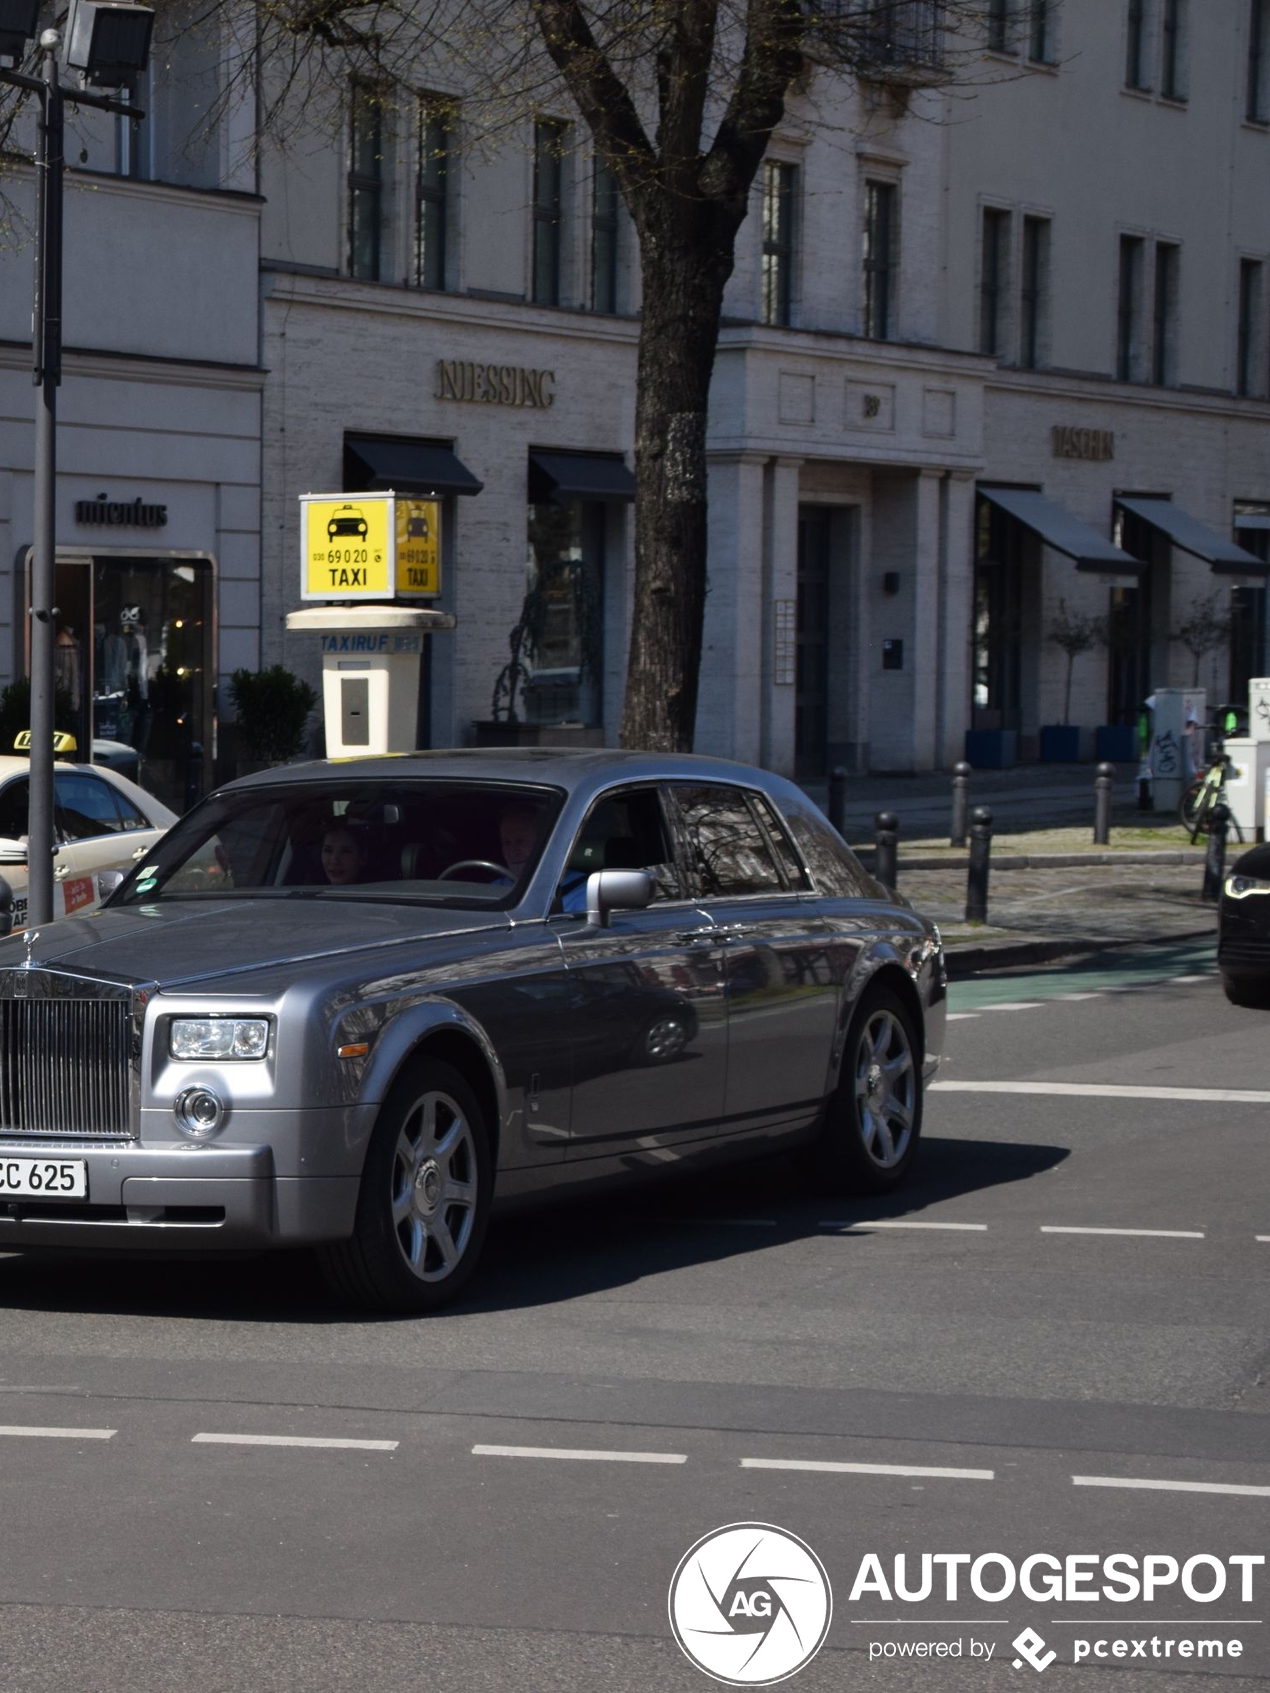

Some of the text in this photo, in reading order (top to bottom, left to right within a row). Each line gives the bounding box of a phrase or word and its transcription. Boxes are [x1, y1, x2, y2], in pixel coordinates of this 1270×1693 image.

[434, 359, 556, 408] NIESSING
[75, 493, 168, 526] mientus
[313, 552, 325, 561] 030
[329, 568, 367, 586] TAXI
[407, 568, 428, 587] TAXI
[320, 635, 389, 652] TAXIRUF
[29, 1164, 75, 1191] 625
